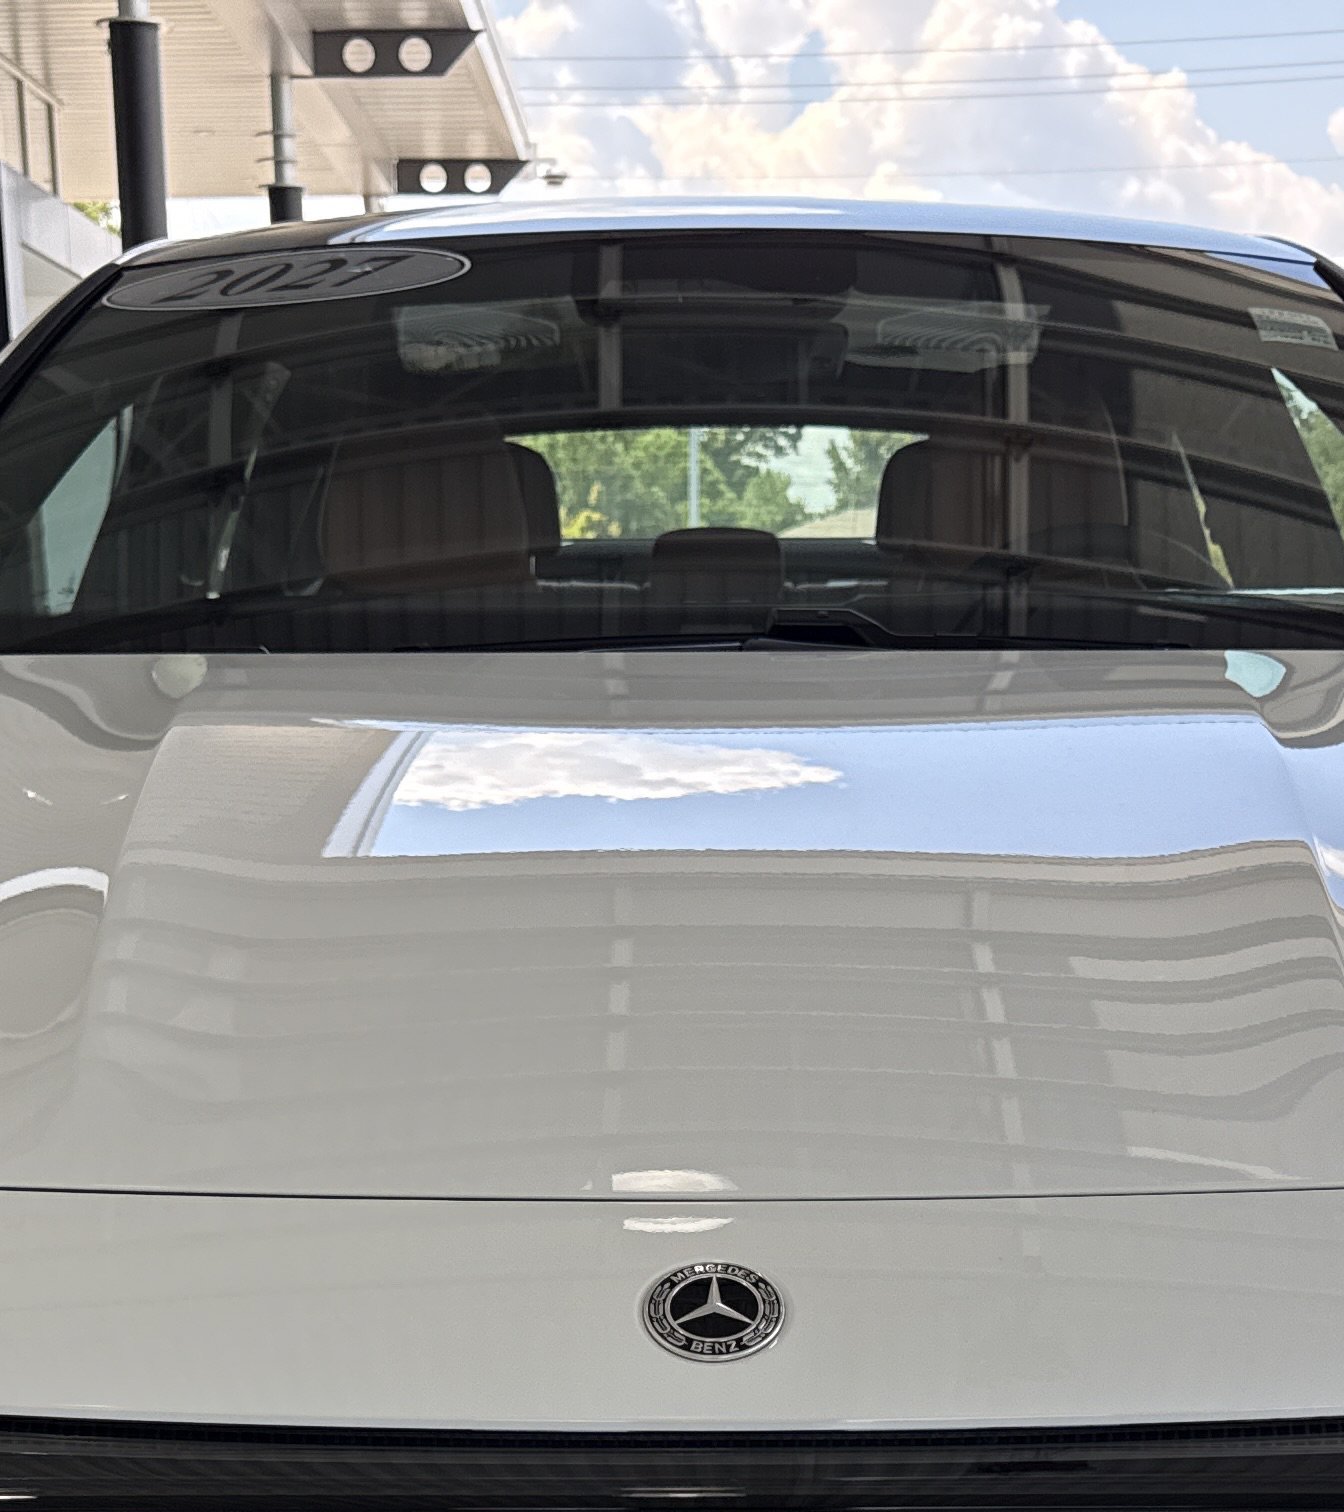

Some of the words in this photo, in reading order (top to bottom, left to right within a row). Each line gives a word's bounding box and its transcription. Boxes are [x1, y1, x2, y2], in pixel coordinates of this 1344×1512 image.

[152, 254, 414, 305] 2027
[670, 1264, 759, 1284] MERCEDES
[690, 1340, 742, 1355] BENZ
